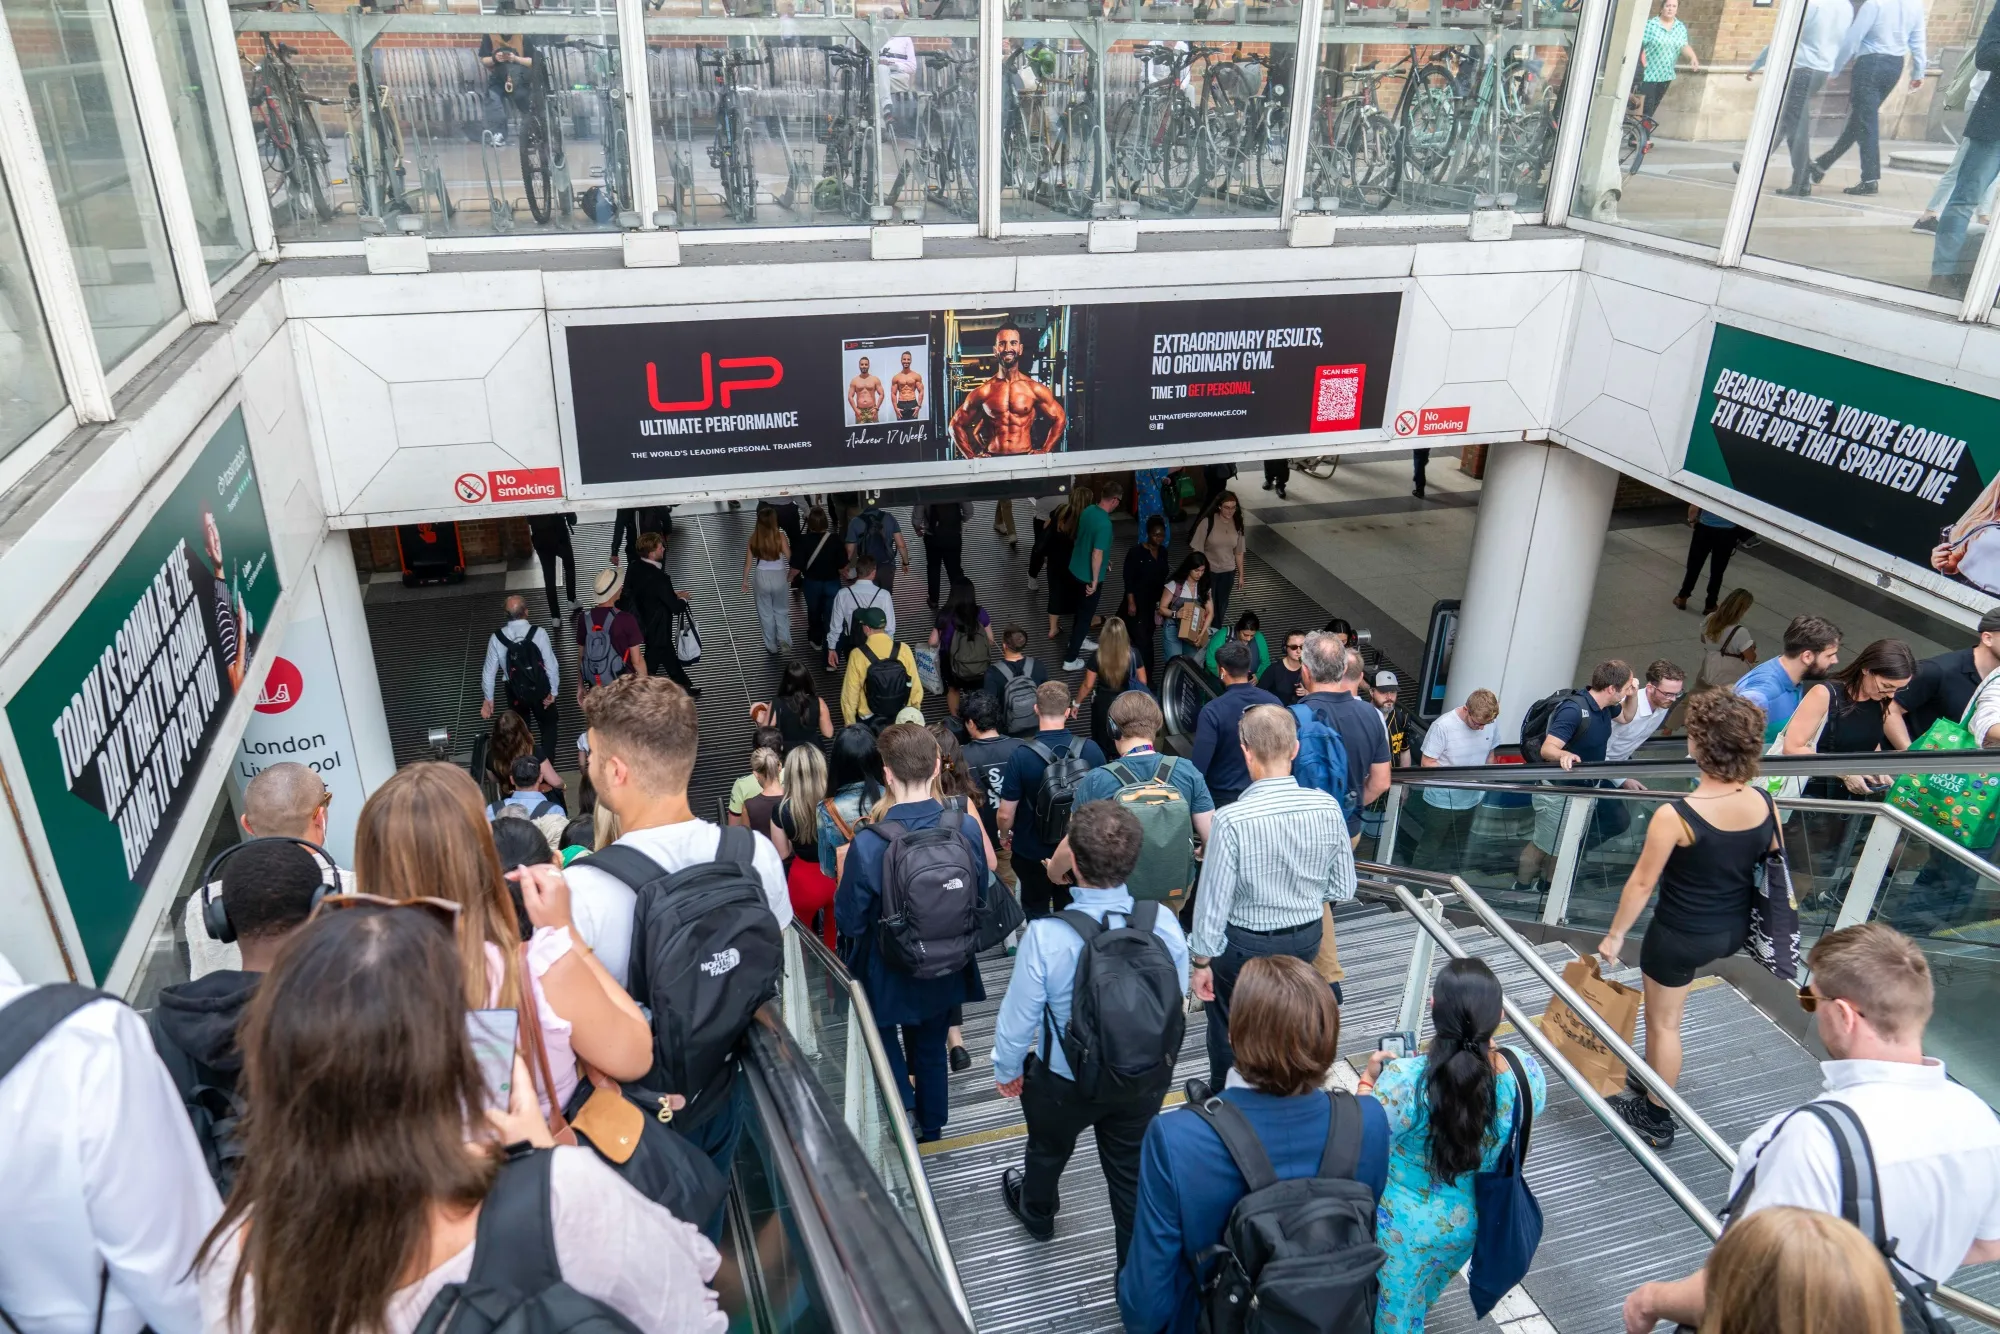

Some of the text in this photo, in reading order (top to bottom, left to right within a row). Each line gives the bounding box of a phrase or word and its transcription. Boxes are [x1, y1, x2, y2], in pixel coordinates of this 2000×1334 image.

[1153, 327, 1323, 354] EXTRAORDINARY RESULTS,
[1152, 351, 1274, 375] NO ORDINARY GYM.
[646, 352, 784, 412] UP
[1151, 381, 1255, 399] TIME TO GET PERSONAL.
[640, 411, 798, 436] ULTIMATE PERFORMANCE
[1149, 410, 1247, 421] ULTIMATEPERFORMANCE.COM
[1424, 420, 1463, 430] smoking
[1425, 412, 1438, 421] No
[1713, 367, 1967, 471] BECAUSE SADIE, YOU'RE GONNA
[846, 425, 927, 448] Andrew 17 Weeks
[650, 449, 688, 458] WORLD'S
[690, 446, 726, 456] LEADING
[728, 444, 771, 453] PERSONAL
[773, 441, 812, 450] TRAINERS
[1710, 399, 1958, 505] FIX THE PIPE THAT SPRAYED ME
[496, 474, 516, 485] No
[498, 484, 555, 497] smoking
[52, 537, 193, 791] TODAY IS GONNA BE THE
[97, 594, 207, 821] DAY THAT I'M GONNA
[242, 734, 326, 754] London
[118, 646, 220, 881] HANG IT UP FOR YOU
[240, 751, 342, 778] Livool
[1929, 774, 1960, 793] FOODS
[701, 958, 731, 971] NORTH
[712, 950, 729, 961] THE
